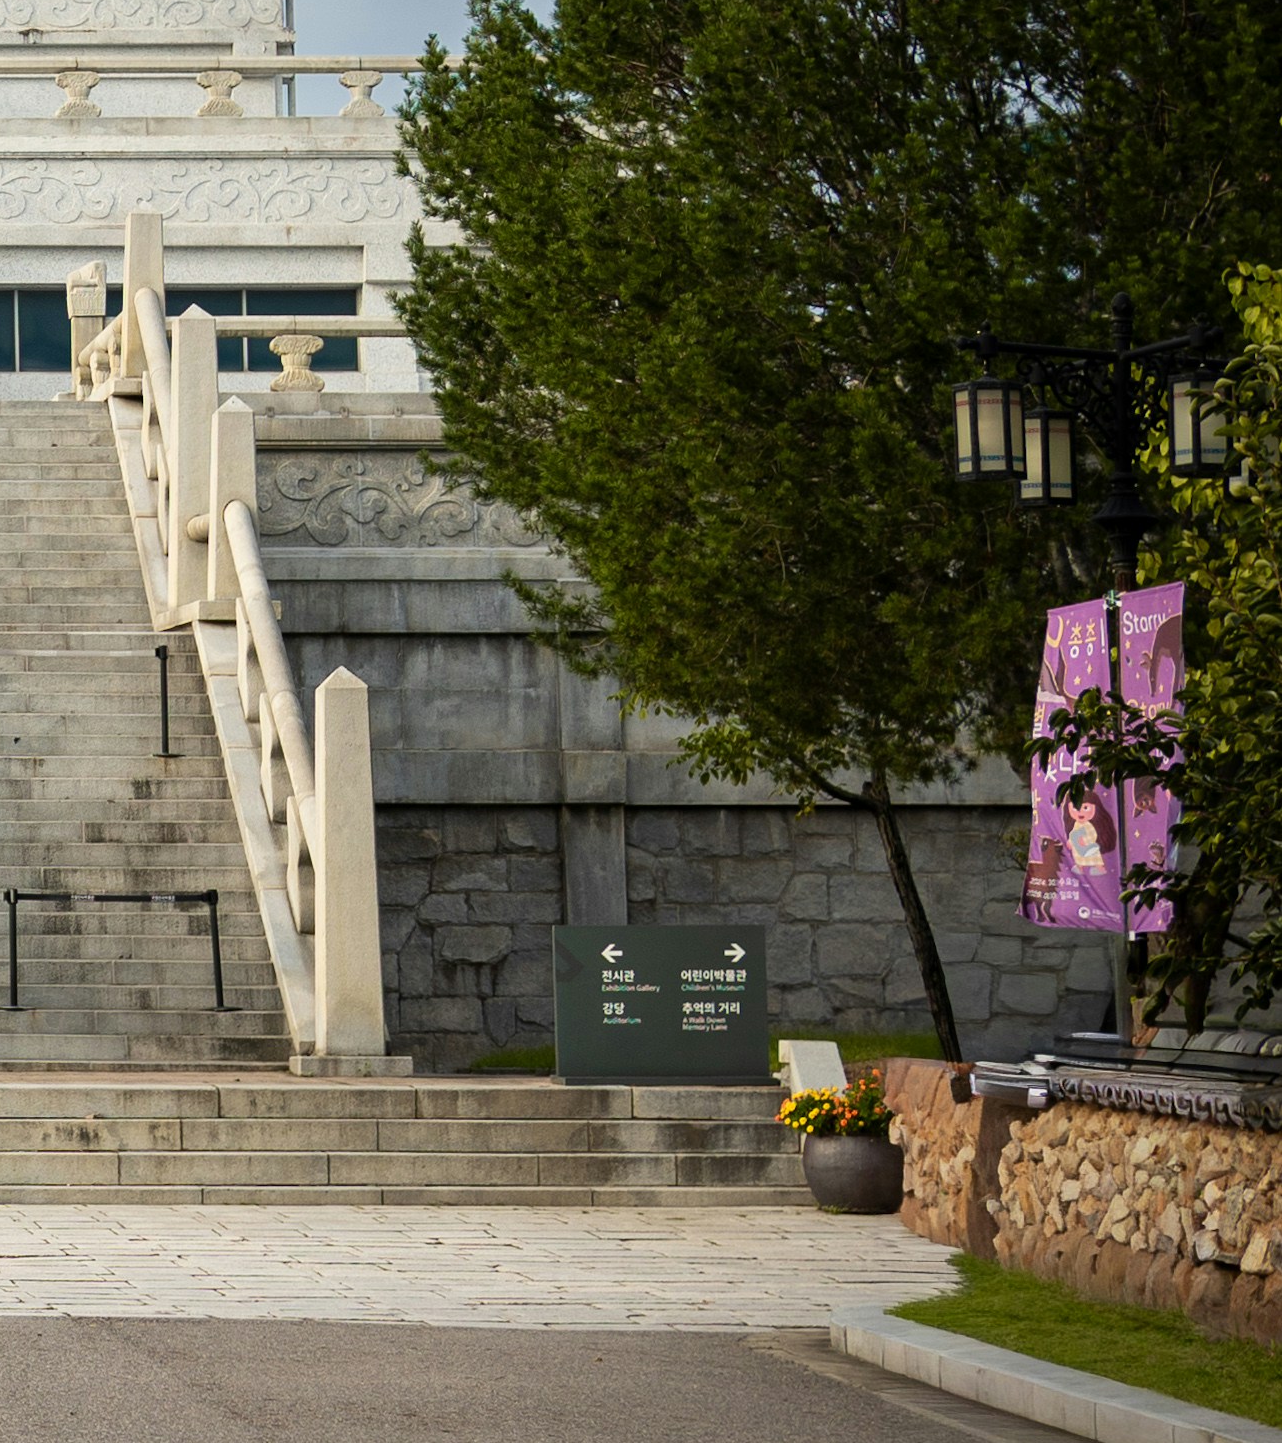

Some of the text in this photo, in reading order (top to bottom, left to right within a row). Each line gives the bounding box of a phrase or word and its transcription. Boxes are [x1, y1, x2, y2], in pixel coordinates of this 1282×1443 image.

[601, 969, 635, 983] 전시관
[680, 969, 747, 983] 어린이박물관
[601, 984, 661, 993] Exhibition Gallery
[716, 984, 745, 992] Museum
[602, 1002, 625, 1015] 강당
[682, 1002, 740, 1015] 추억의 거리
[682, 1024, 728, 1032] Memory Lane
